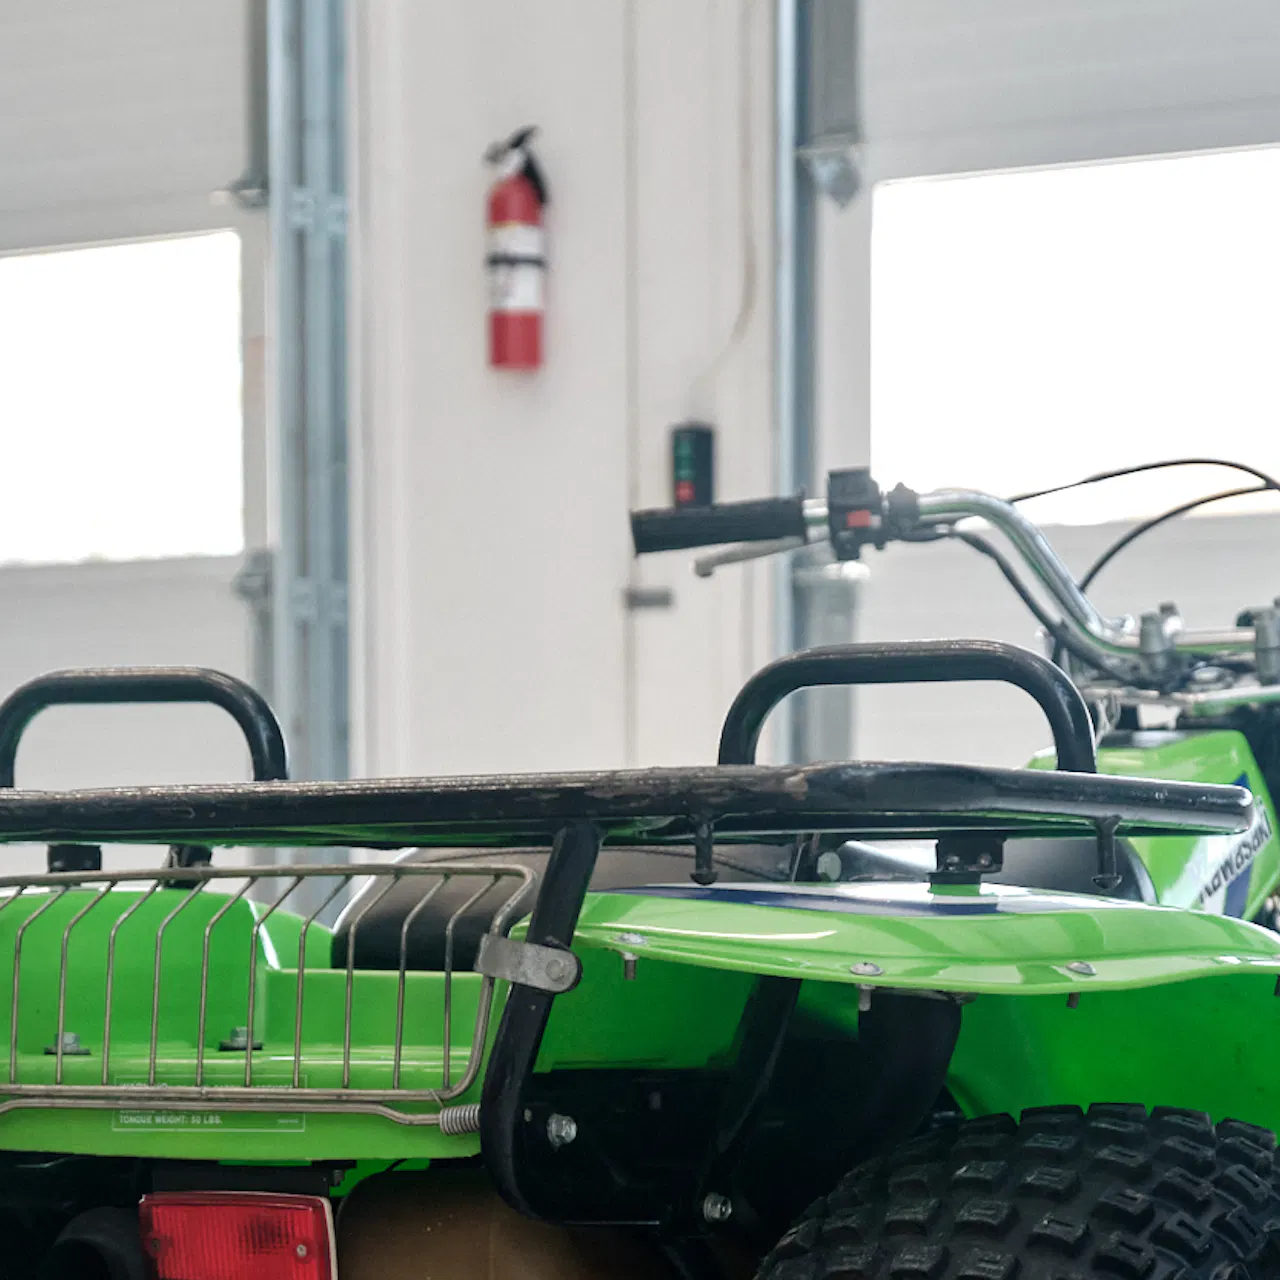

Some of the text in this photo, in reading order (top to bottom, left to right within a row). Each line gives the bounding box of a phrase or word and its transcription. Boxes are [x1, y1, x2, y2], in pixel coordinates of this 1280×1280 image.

[1200, 808, 1272, 904] Kawasaki
[119, 1114, 153, 1125] TONGUE
[154, 1114, 188, 1125] WEIGHT:
